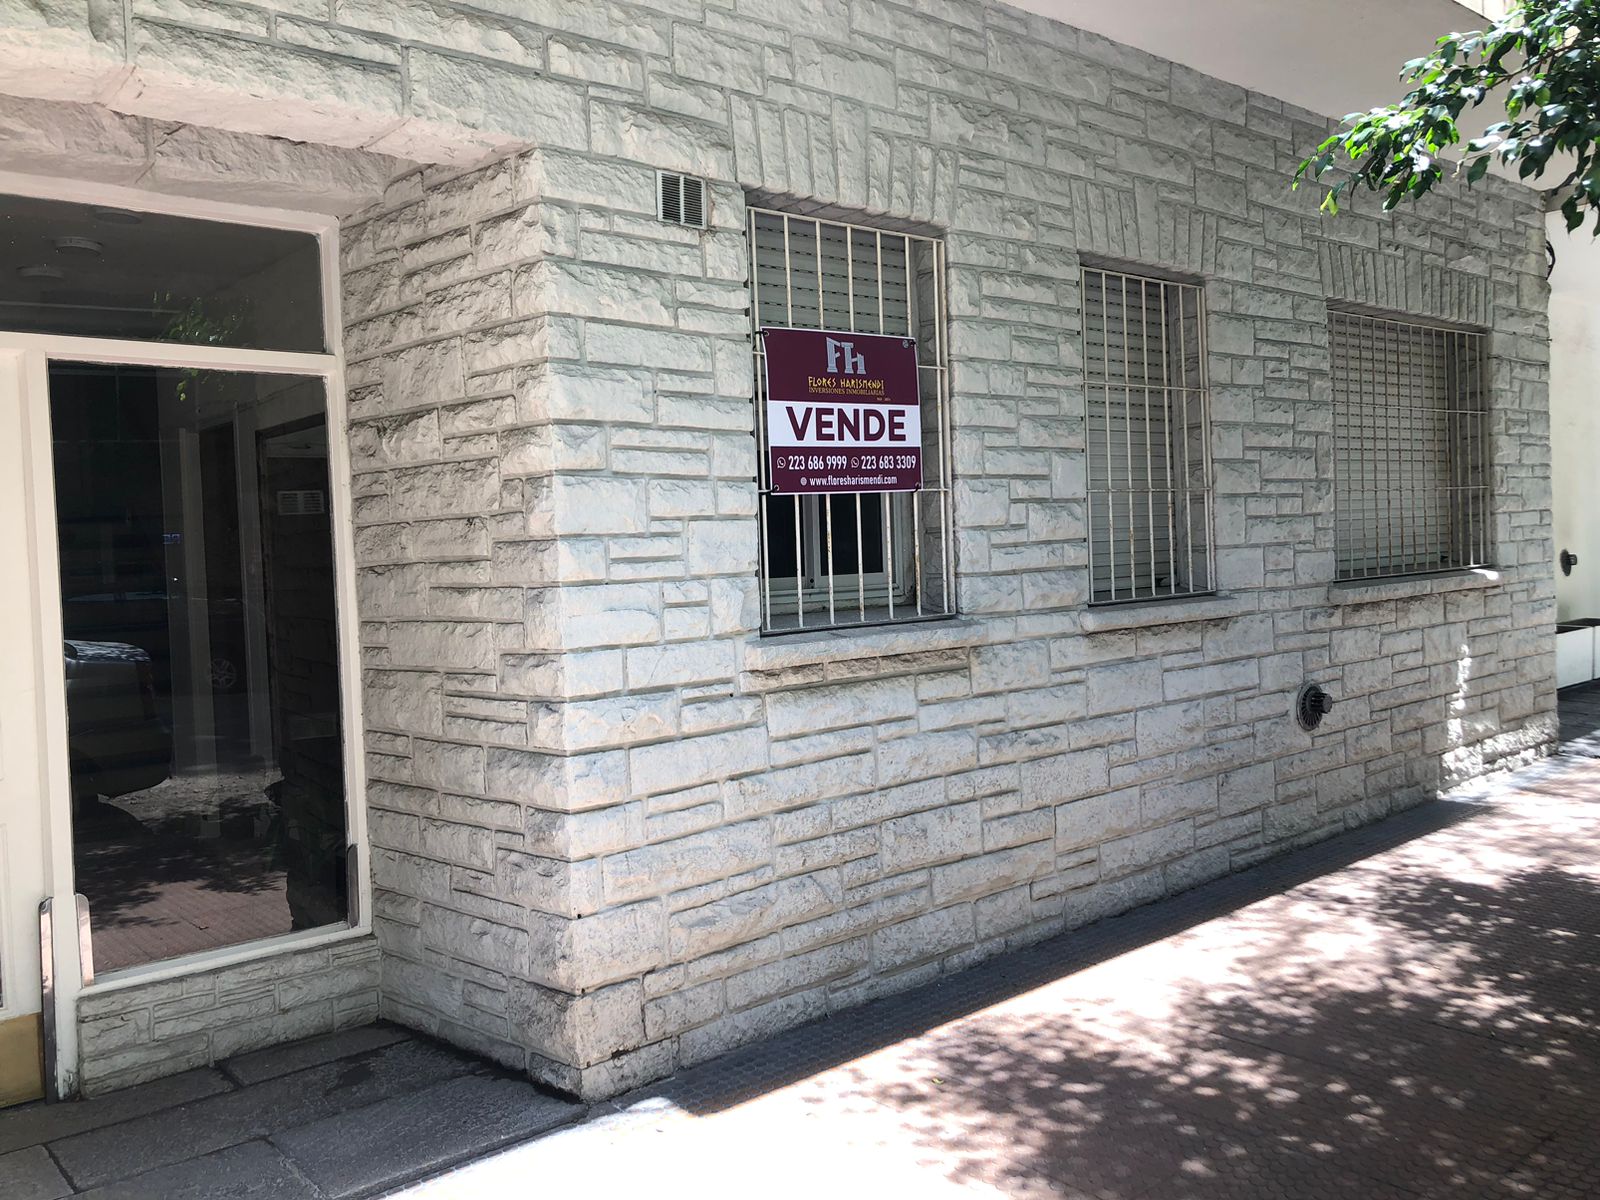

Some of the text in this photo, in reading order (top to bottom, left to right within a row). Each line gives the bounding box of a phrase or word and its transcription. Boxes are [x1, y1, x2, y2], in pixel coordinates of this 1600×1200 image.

[808, 375, 885, 390] FLORES HARISMENDI
[808, 387, 885, 396] INVERSIONES INMOBILIARIAS
[786, 406, 907, 442] VENDE
[788, 455, 848, 470] 223 686 9999
[861, 455, 917, 469] 223 683 3309
[809, 474, 898, 486] www.floresharismendi.com
